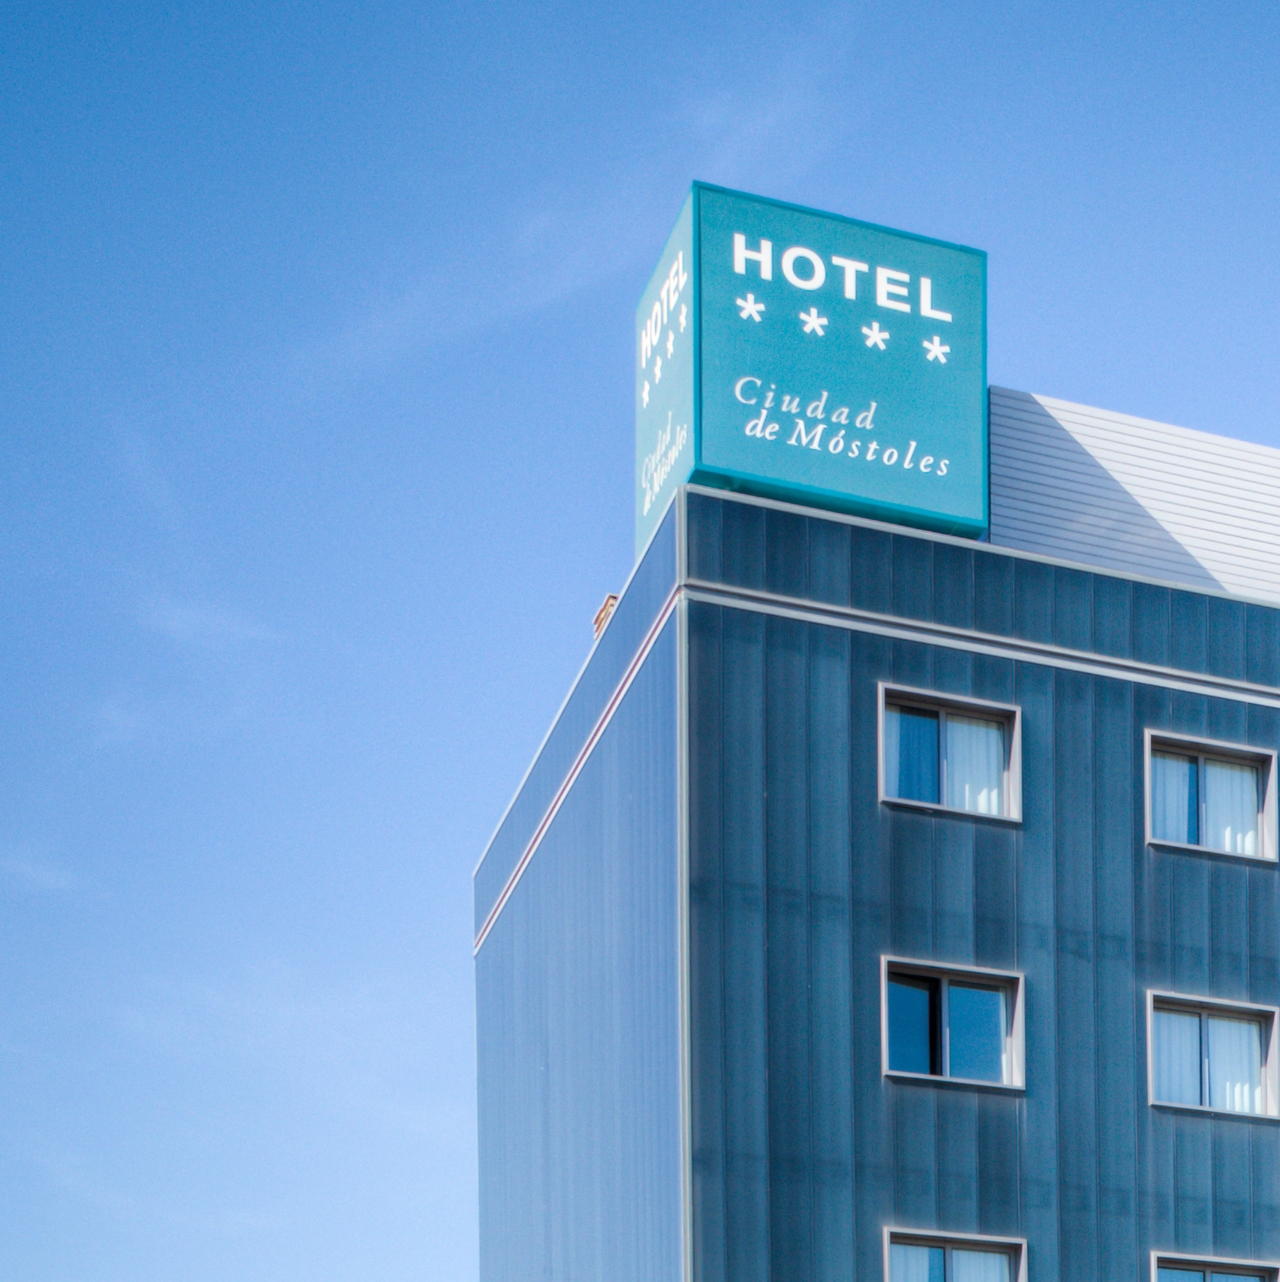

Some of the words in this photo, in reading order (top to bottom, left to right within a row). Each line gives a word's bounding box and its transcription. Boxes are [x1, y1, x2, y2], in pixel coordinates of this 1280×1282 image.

[641, 250, 688, 370] HOTEL
[733, 232, 953, 322] HOTEL
[734, 376, 878, 431] Ciudad
[745, 409, 778, 440] de
[787, 418, 951, 476] Móstoles
